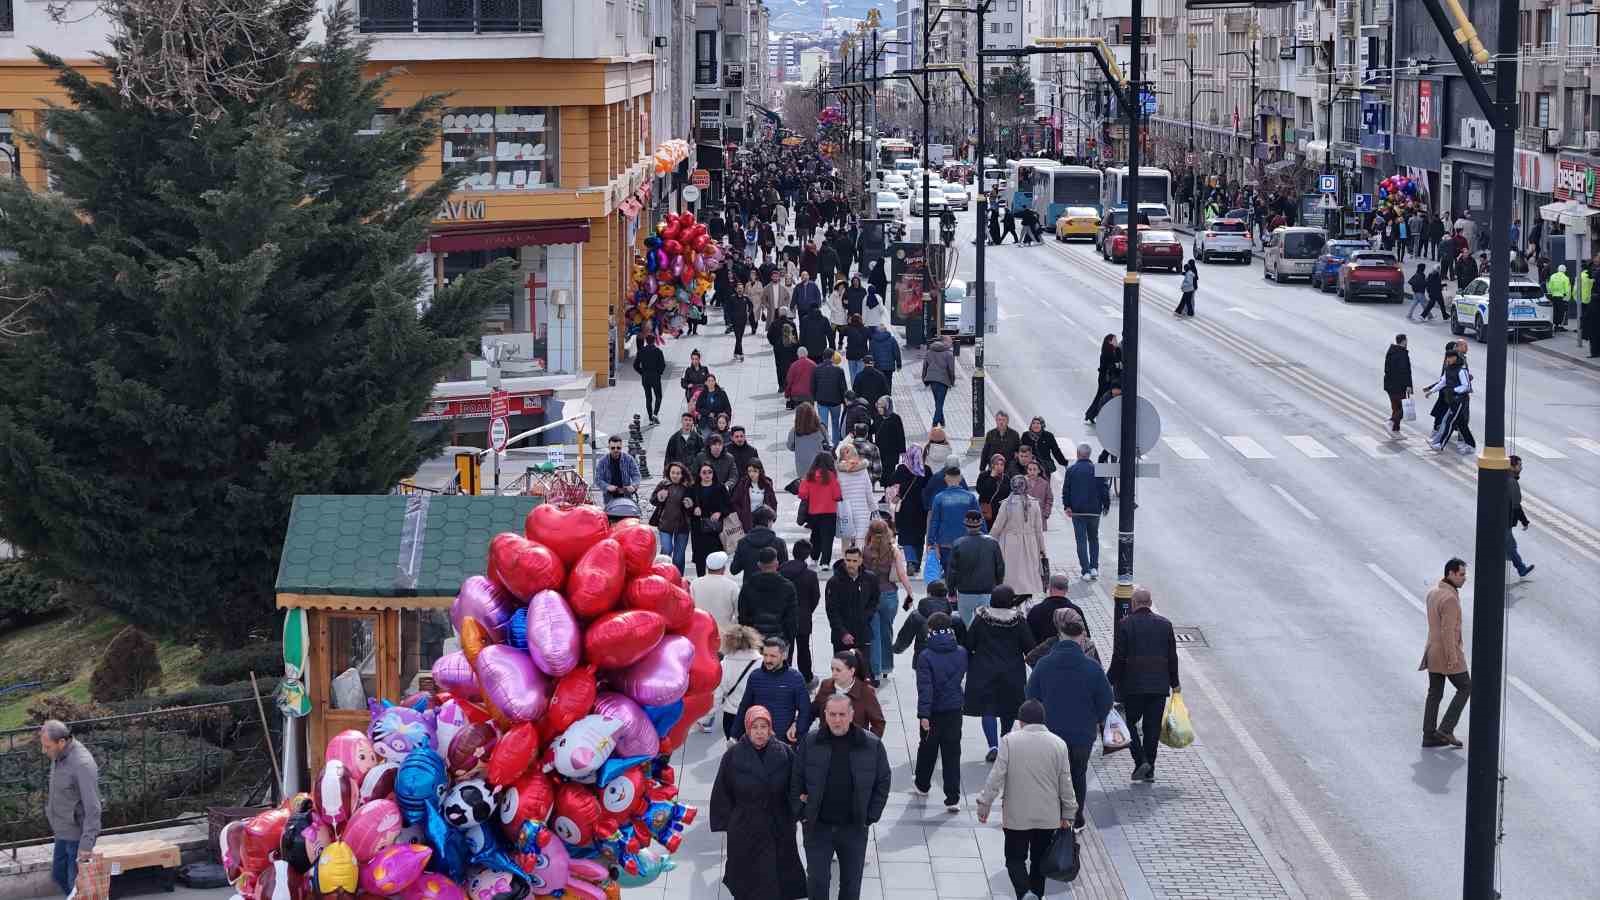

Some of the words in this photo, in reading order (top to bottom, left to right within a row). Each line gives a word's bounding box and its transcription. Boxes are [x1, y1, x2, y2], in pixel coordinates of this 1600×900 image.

[1420, 96, 1430, 124] 50
[1325, 179, 1332, 188] D
[1356, 195, 1364, 207] P
[438, 200, 486, 220] AVM
